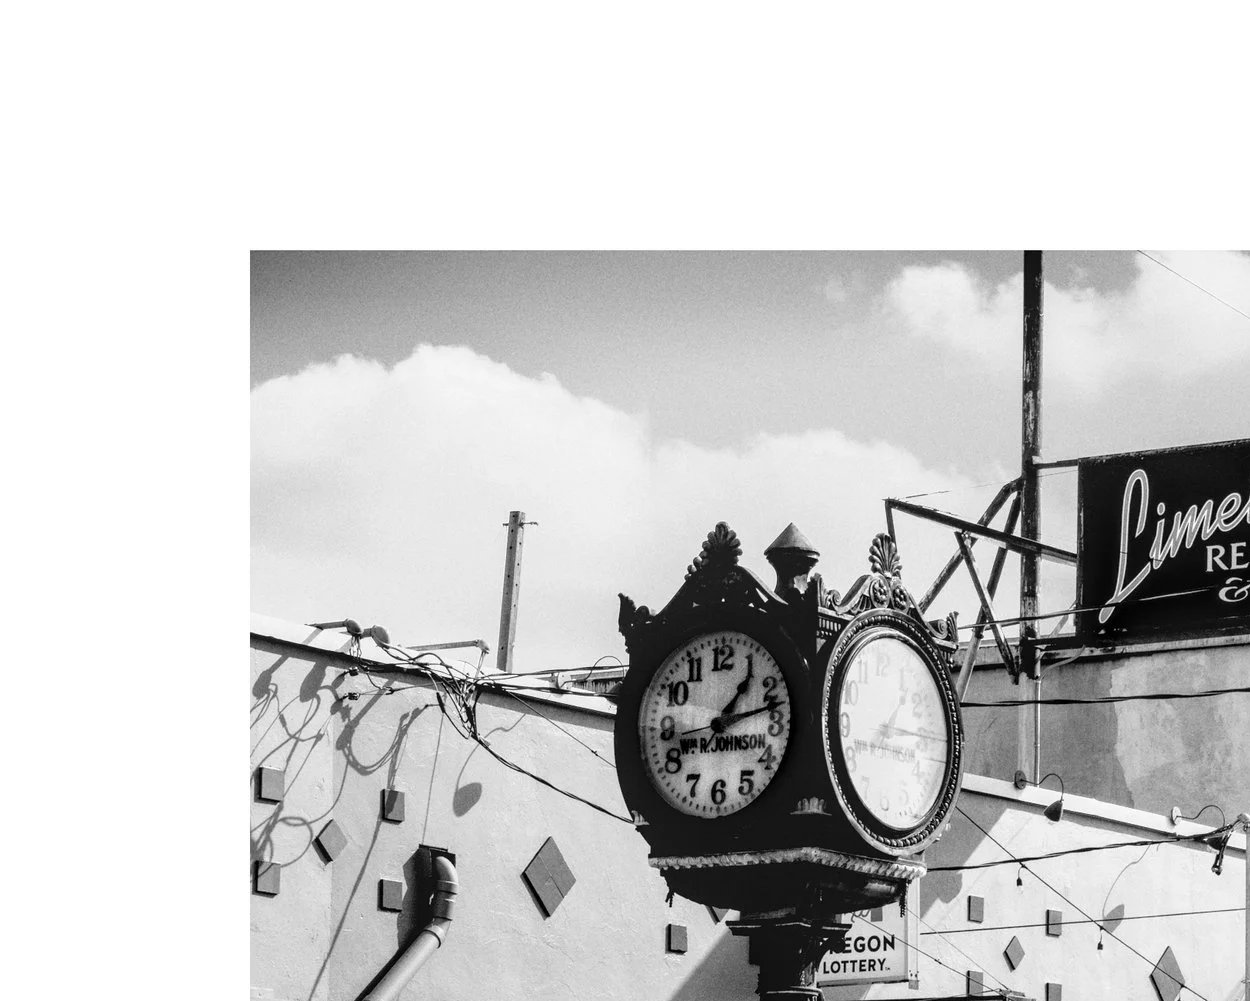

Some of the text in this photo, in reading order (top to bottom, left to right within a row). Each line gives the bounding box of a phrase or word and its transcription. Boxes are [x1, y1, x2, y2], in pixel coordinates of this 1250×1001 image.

[1218, 576, 1250, 602] &
[687, 656, 703, 683] 11
[711, 644, 735, 673] 12
[667, 680, 689, 707] 10
[762, 675, 778, 702] 2
[660, 715, 676, 741] 9
[768, 710, 783, 737] 3
[711, 733, 766, 753] JOHNSON
[665, 747, 682, 774] 8
[758, 744, 777, 771] 4
[686, 773, 701, 798] 7
[711, 778, 727, 805] 6
[738, 769, 755, 796] 5
